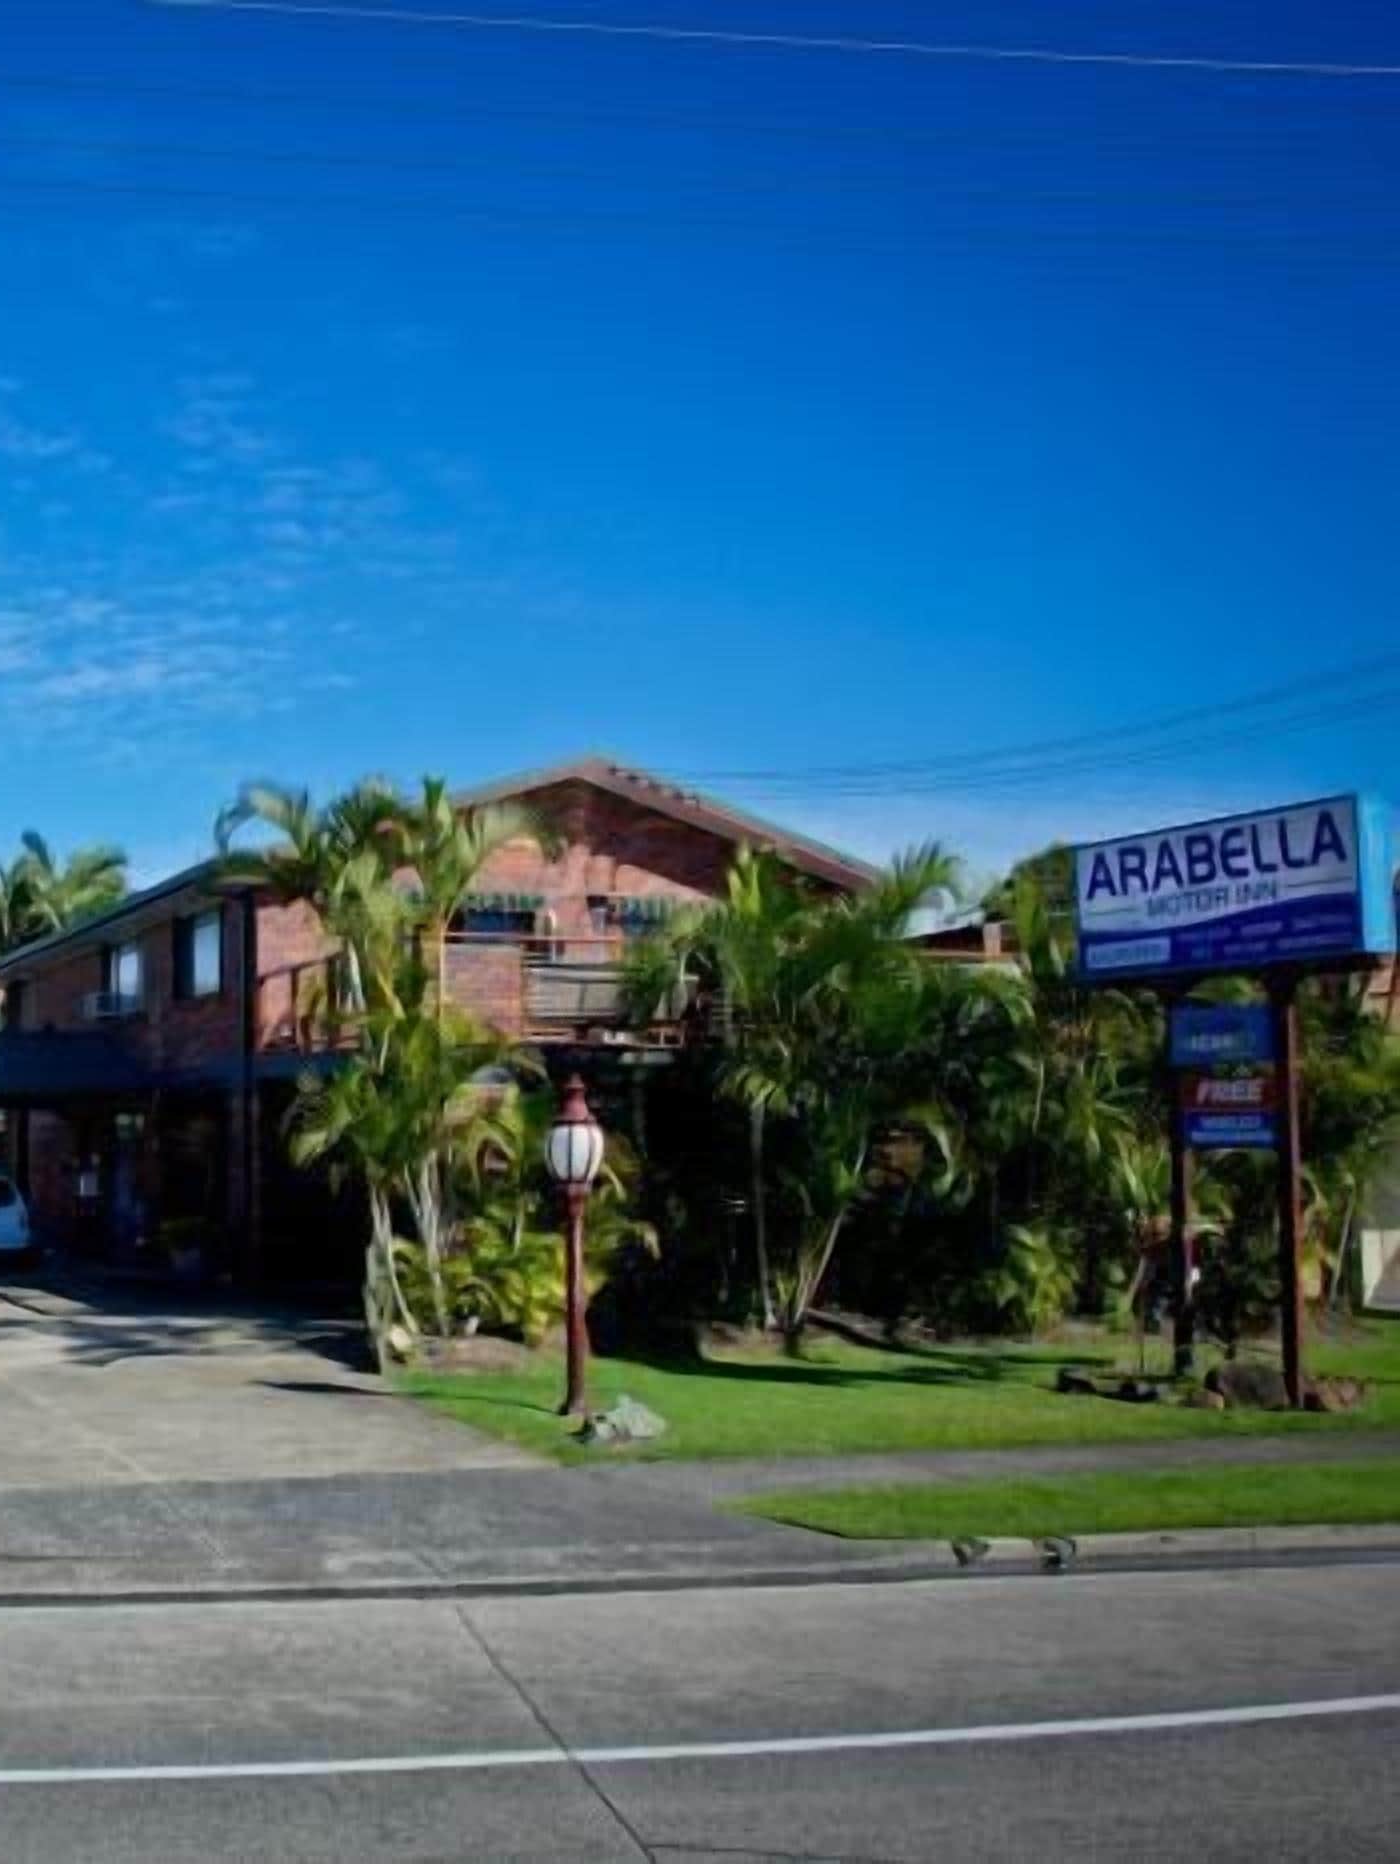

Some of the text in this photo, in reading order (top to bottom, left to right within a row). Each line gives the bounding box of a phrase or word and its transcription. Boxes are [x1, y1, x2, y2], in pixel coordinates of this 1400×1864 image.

[1086, 810, 1348, 900] ARABELLA
[1147, 880, 1278, 917] MOTOR INN
